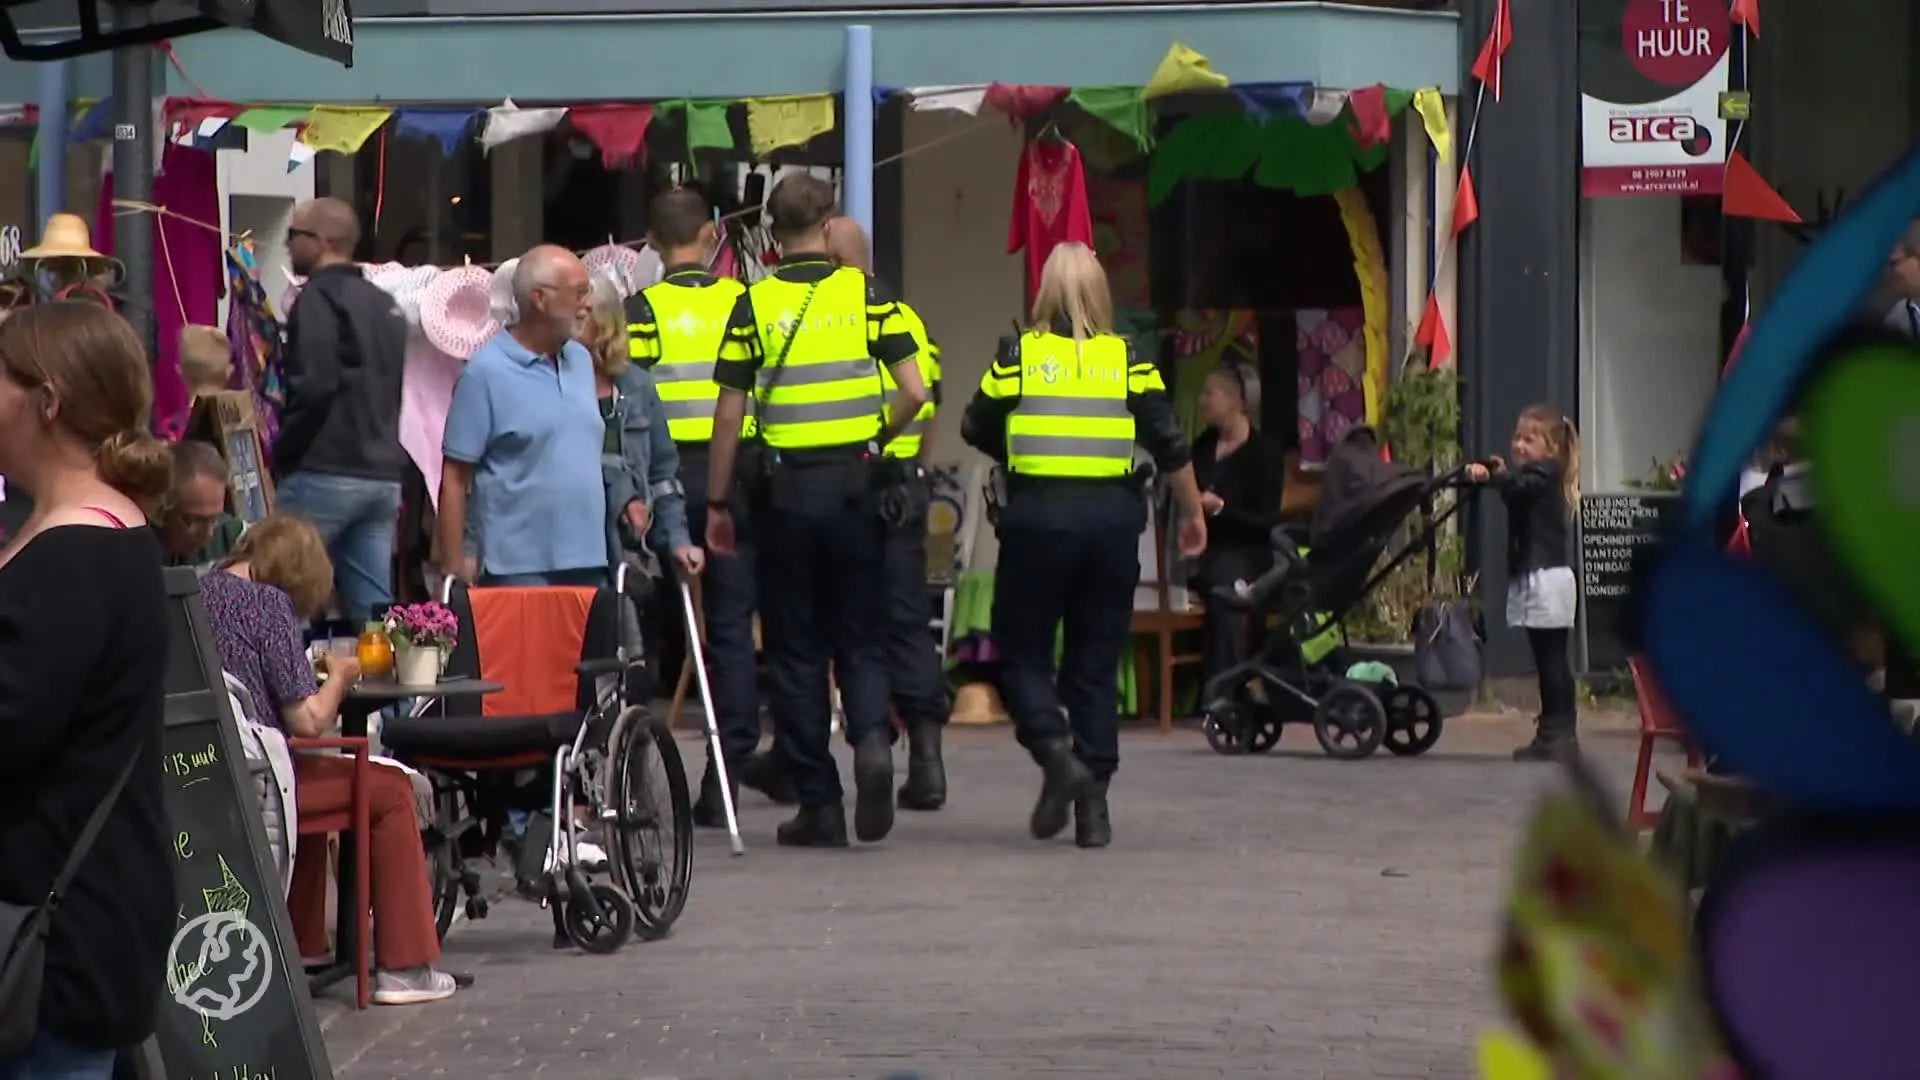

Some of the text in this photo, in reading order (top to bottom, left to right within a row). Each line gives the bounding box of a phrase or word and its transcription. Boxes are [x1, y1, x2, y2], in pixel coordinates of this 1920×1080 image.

[1660, 0, 1690, 23] TE
[1637, 28, 1712, 58] HUUR
[1610, 116, 1696, 142] arca
[1583, 518, 1633, 529] CENTRALE
[1584, 549, 1633, 559] KANTOOR
[1585, 573, 1600, 585] EN
[172, 751, 190, 776] 13
